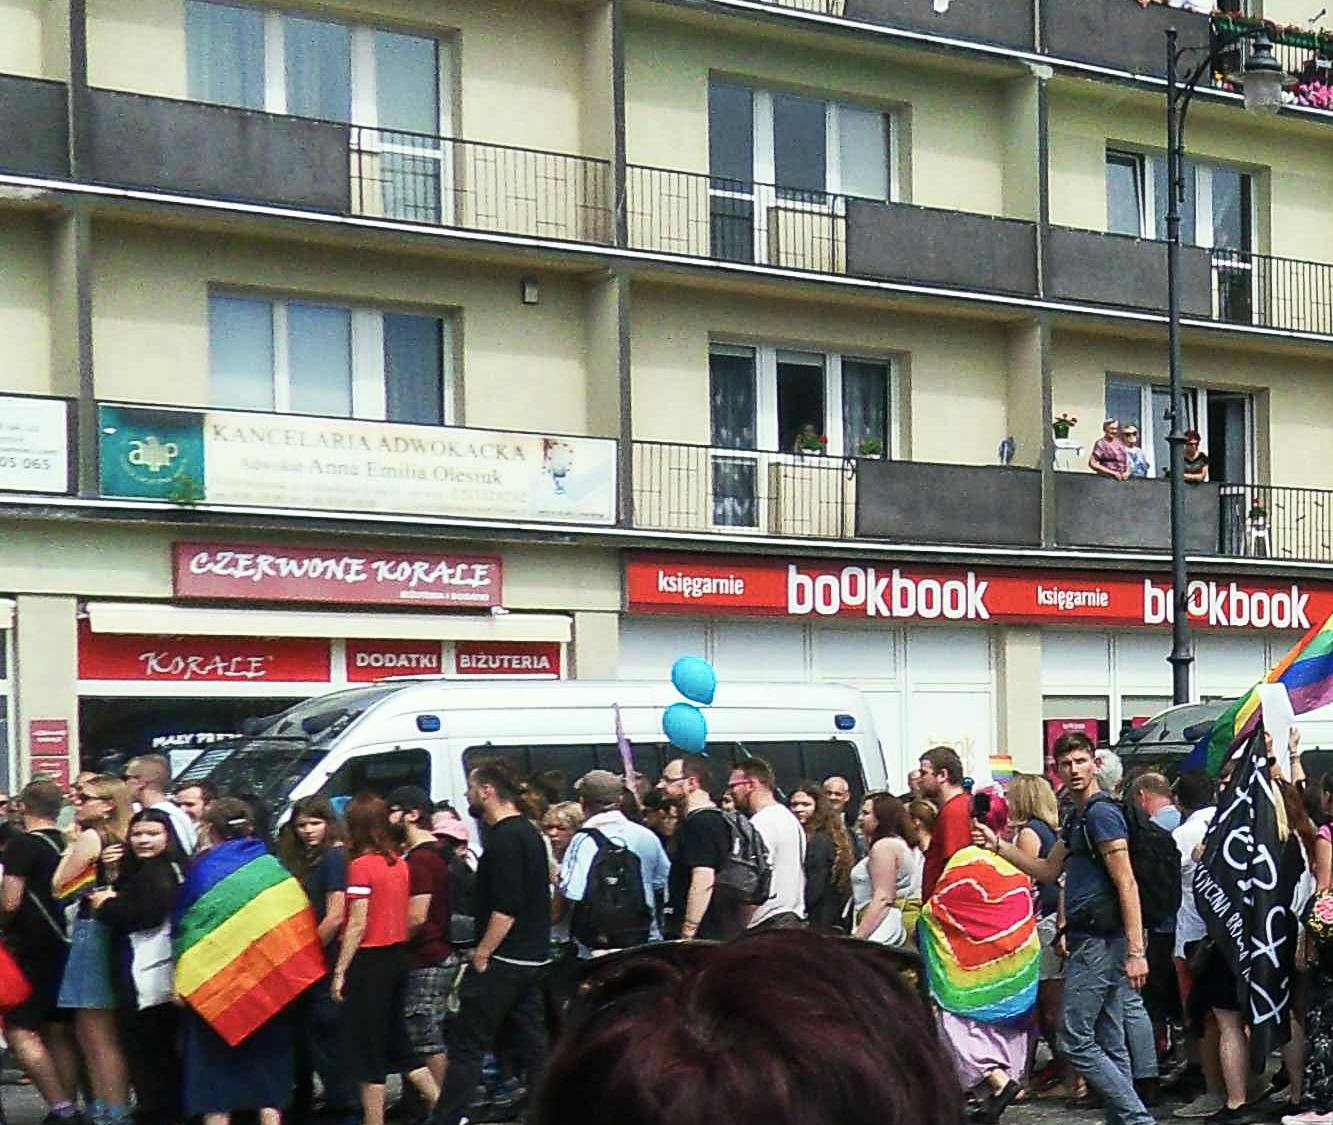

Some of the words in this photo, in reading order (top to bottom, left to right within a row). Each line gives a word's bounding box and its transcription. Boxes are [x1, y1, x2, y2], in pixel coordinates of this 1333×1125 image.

[212, 424, 370, 449] KANCELARIA
[378, 436, 527, 461] ADWOKACKA
[308, 459, 359, 477] Anna
[189, 551, 368, 583] CZERWONE
[371, 559, 493, 587] KORALE
[658, 571, 744, 598] księgarnie
[787, 564, 990, 620] bookbook
[1037, 585, 1109, 610] księgarnie
[138, 652, 267, 679] KORALE
[356, 651, 438, 668] DODATKI
